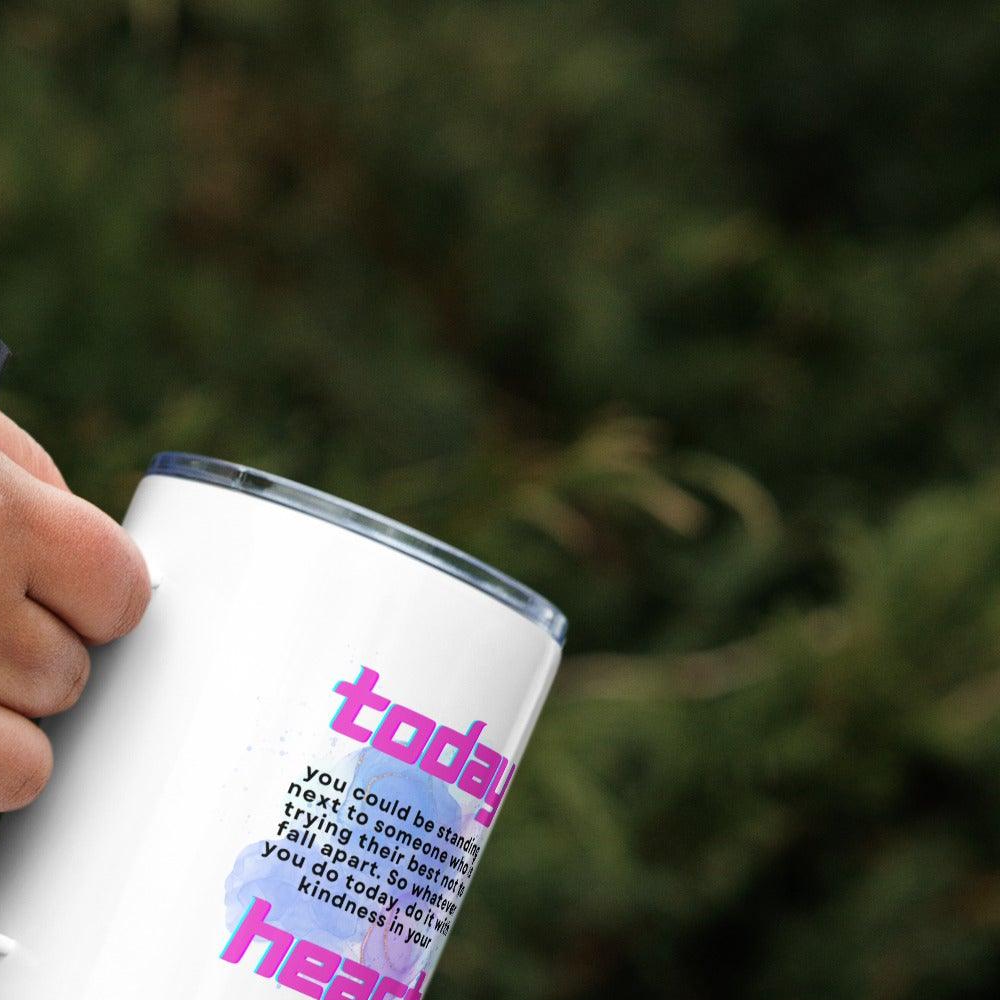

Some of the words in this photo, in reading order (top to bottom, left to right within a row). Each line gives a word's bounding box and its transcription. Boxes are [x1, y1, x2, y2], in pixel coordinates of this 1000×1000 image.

[330, 665, 516, 828] today
[287, 782, 341, 813] next
[347, 805, 369, 825] to
[374, 819, 448, 863] someone
[449, 855, 469, 875] who
[302, 765, 347, 793] you
[352, 787, 411, 821] could
[413, 810, 435, 832] be
[261, 840, 305, 869] you
[311, 861, 339, 883] do
[345, 874, 401, 915] today,
[405, 902, 423, 922] do
[424, 908, 435, 928] it
[277, 820, 317, 849] fall
[320, 843, 381, 879] apart.
[387, 869, 408, 890] So
[411, 883, 457, 916] whatever
[284, 801, 353, 845] trying
[359, 833, 405, 865] their
[407, 855, 440, 883] best
[440, 875, 459, 893] not
[297, 876, 387, 927] kindness
[389, 916, 404, 936] in
[404, 927, 432, 949] your
